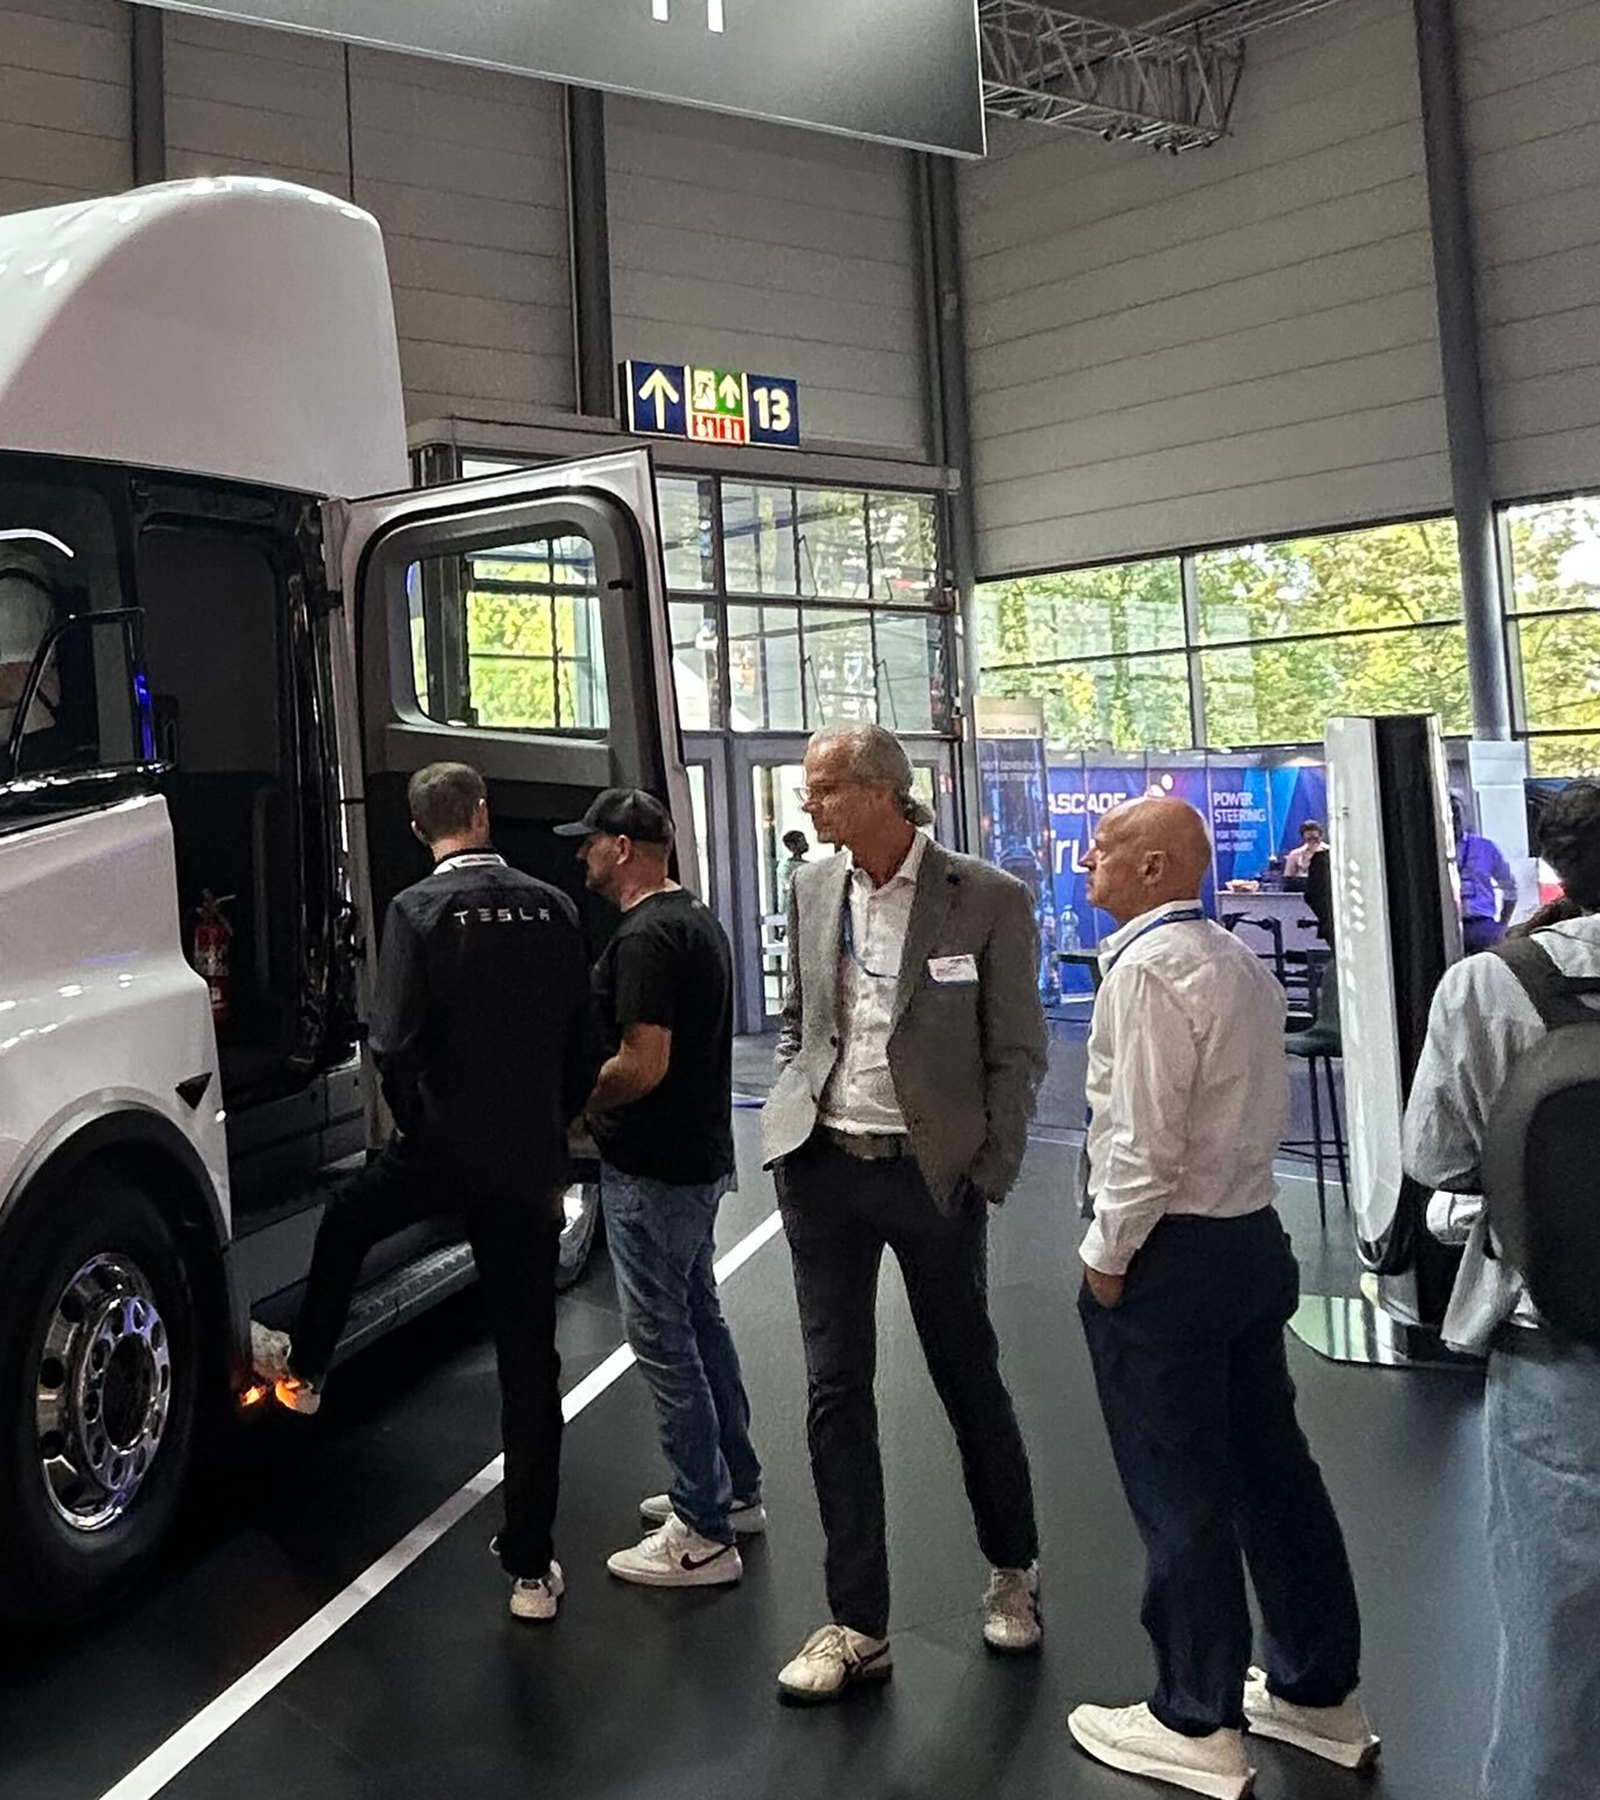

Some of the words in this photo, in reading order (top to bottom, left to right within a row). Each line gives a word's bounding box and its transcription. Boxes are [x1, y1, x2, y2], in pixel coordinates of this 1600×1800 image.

[753, 387, 791, 431] 13
[1047, 792, 1127, 815] ASCAD
[1213, 792, 1254, 807] POWER
[1214, 808, 1267, 823] STEERING
[453, 907, 550, 925] TESLA
